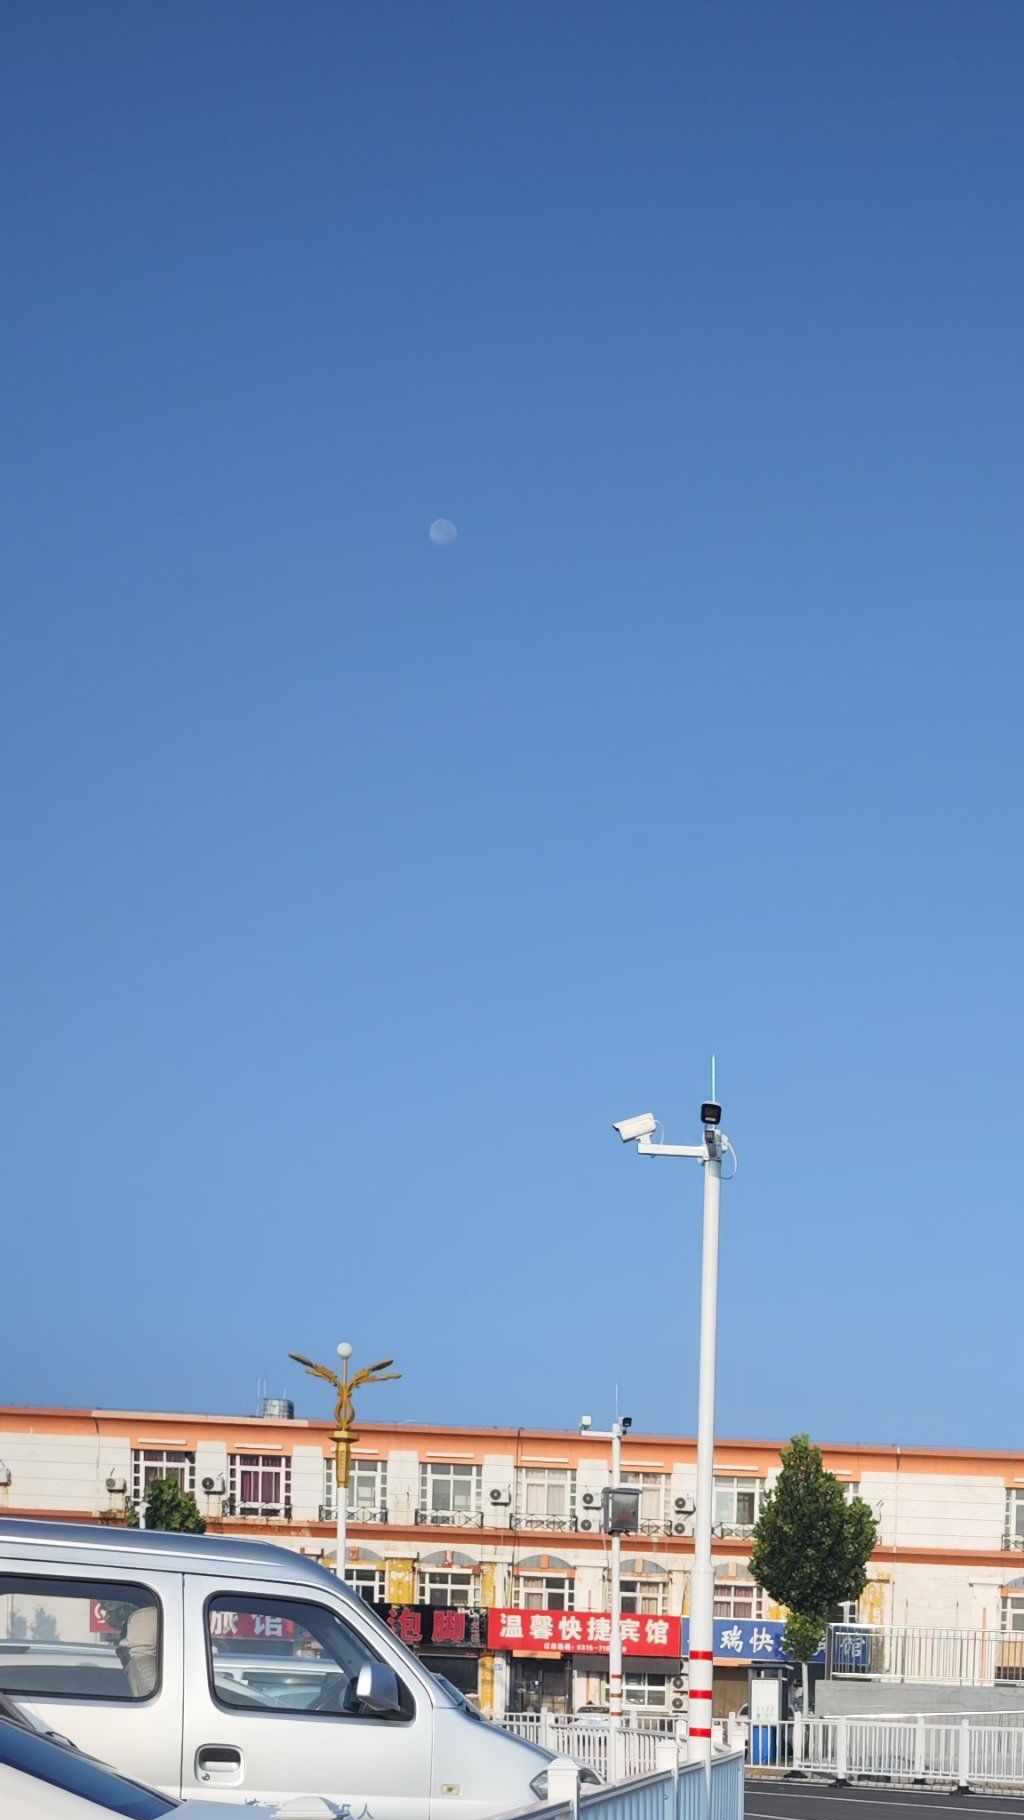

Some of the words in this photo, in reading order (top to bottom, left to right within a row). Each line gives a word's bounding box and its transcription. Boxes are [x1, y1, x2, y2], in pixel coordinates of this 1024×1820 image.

[499, 1613, 670, 1645] 温馨快捷宾馆
